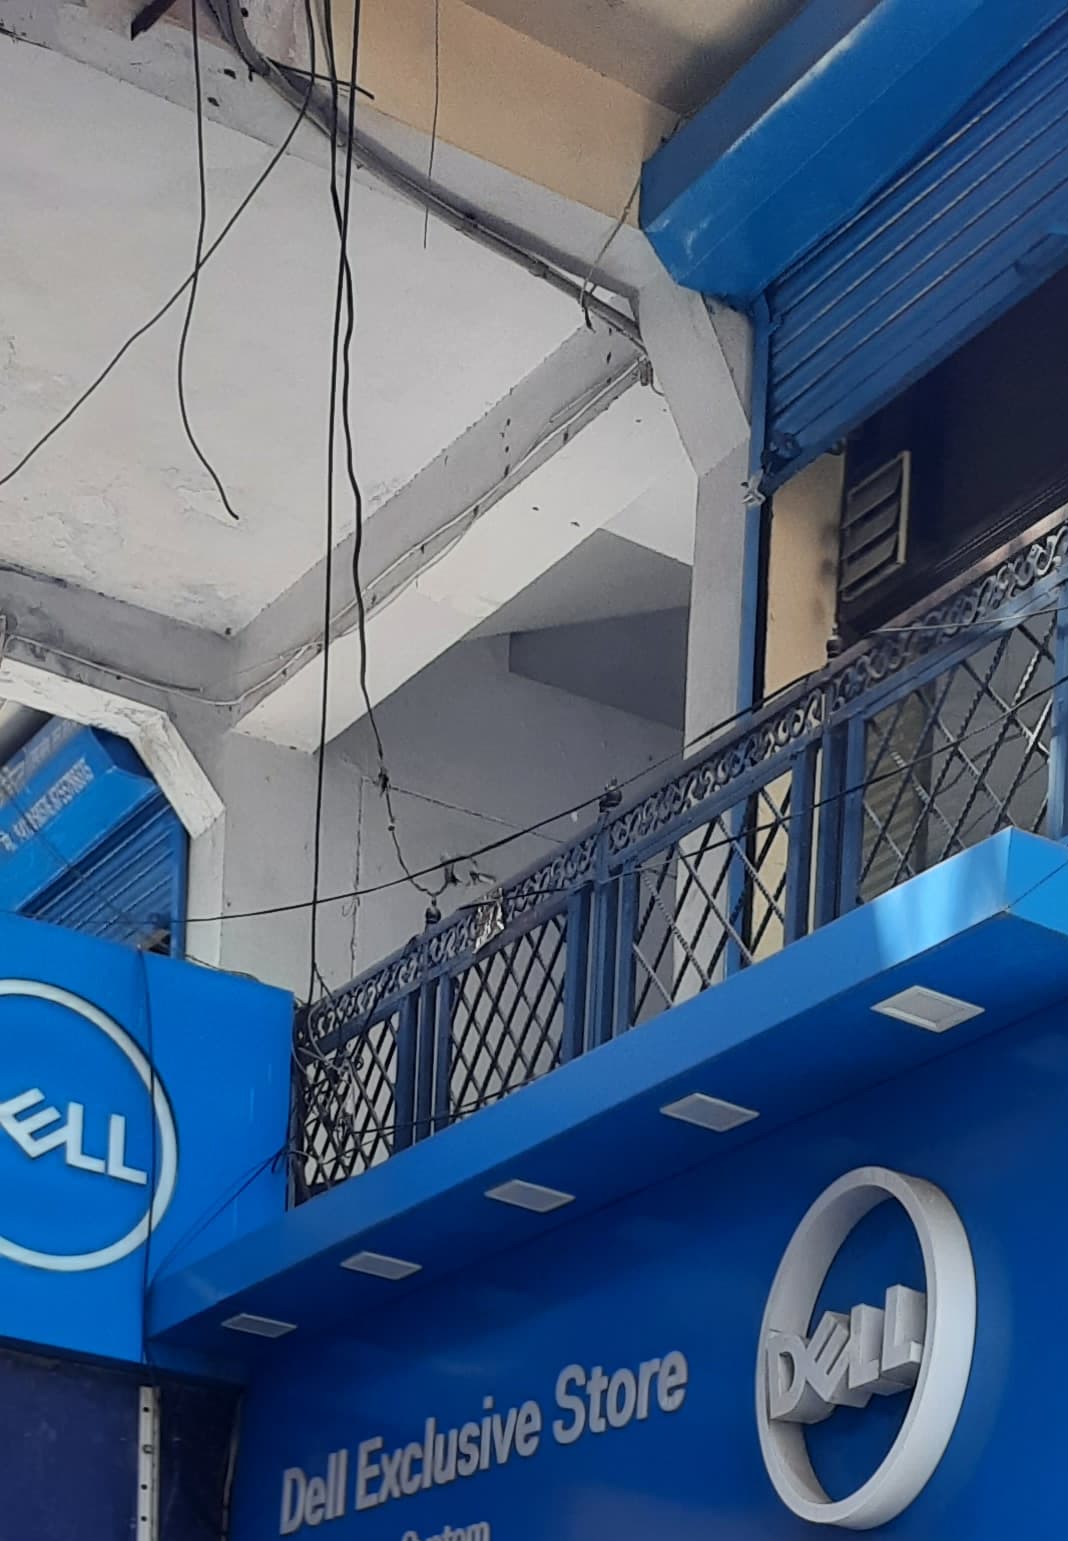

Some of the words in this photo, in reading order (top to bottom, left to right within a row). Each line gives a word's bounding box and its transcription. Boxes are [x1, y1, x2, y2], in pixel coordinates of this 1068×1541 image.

[0, 1087, 147, 1185] ELL
[766, 1284, 928, 1424] DELL
[280, 1448, 349, 1535] Dell
[354, 1395, 543, 1511] Exclusive
[552, 1350, 688, 1444] Store
